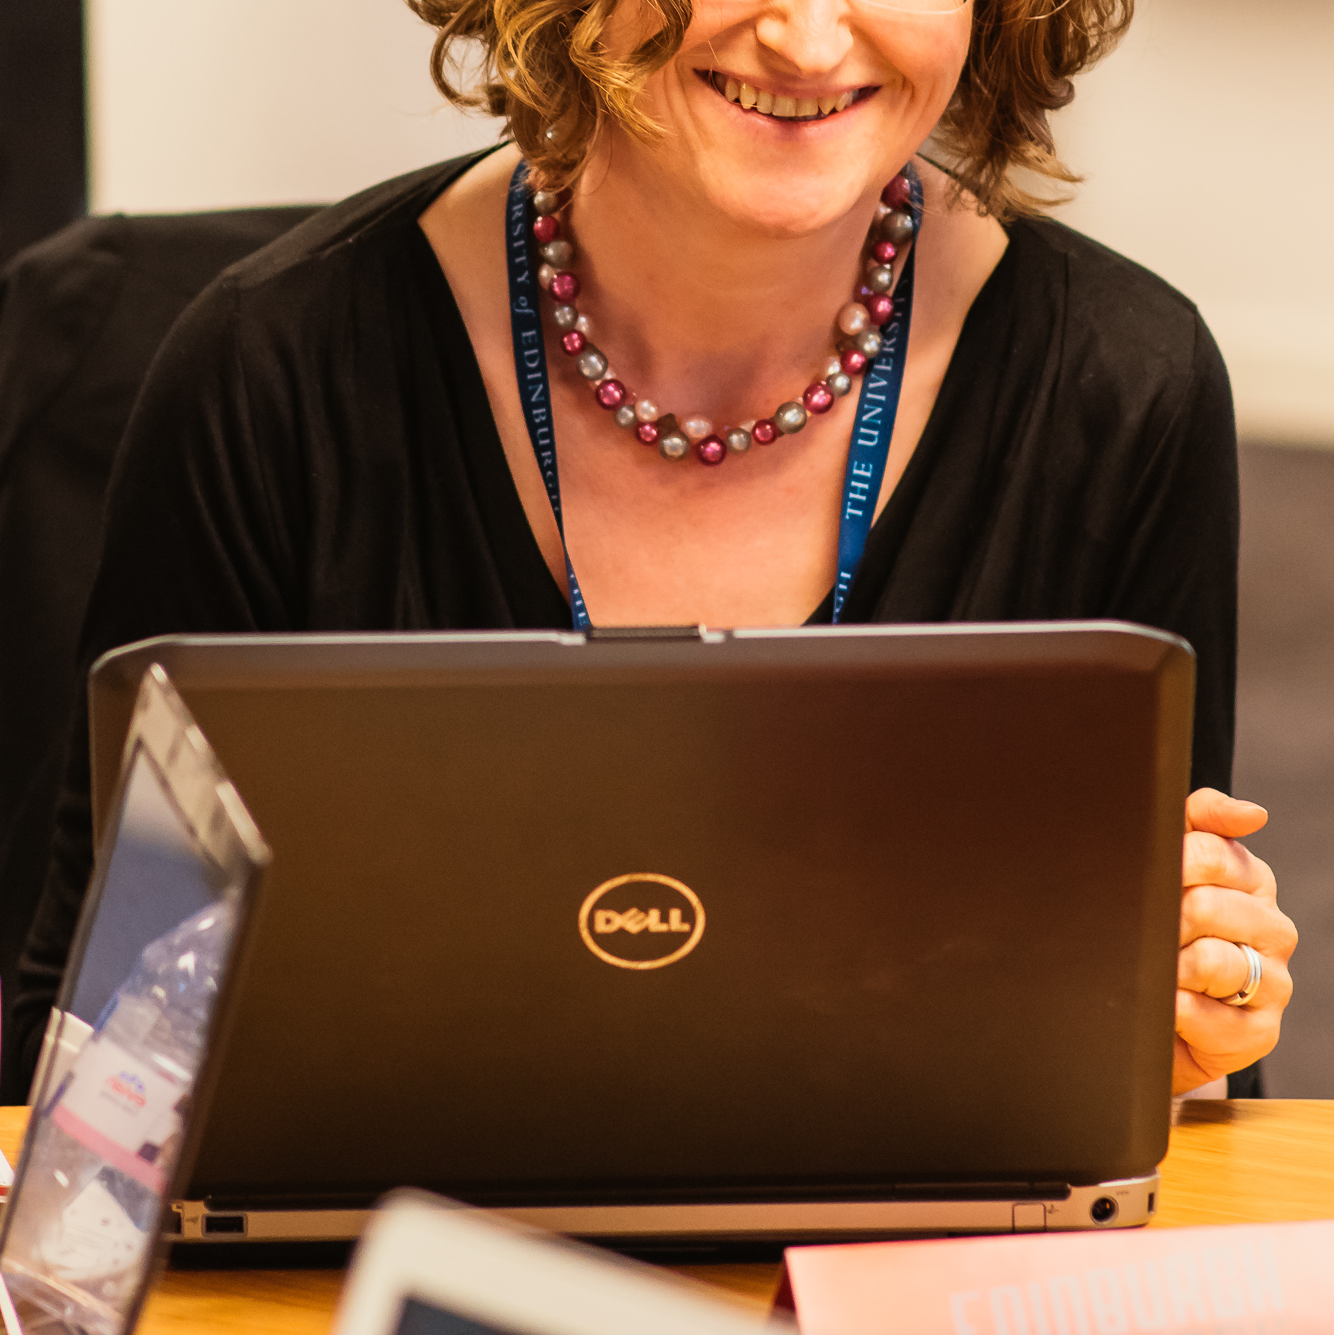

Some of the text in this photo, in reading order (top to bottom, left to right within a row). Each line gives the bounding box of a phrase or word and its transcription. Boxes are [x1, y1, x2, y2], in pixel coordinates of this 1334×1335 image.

[513, 295, 536, 318] of
[845, 459, 874, 520] THE
[593, 906, 692, 935] DELL
